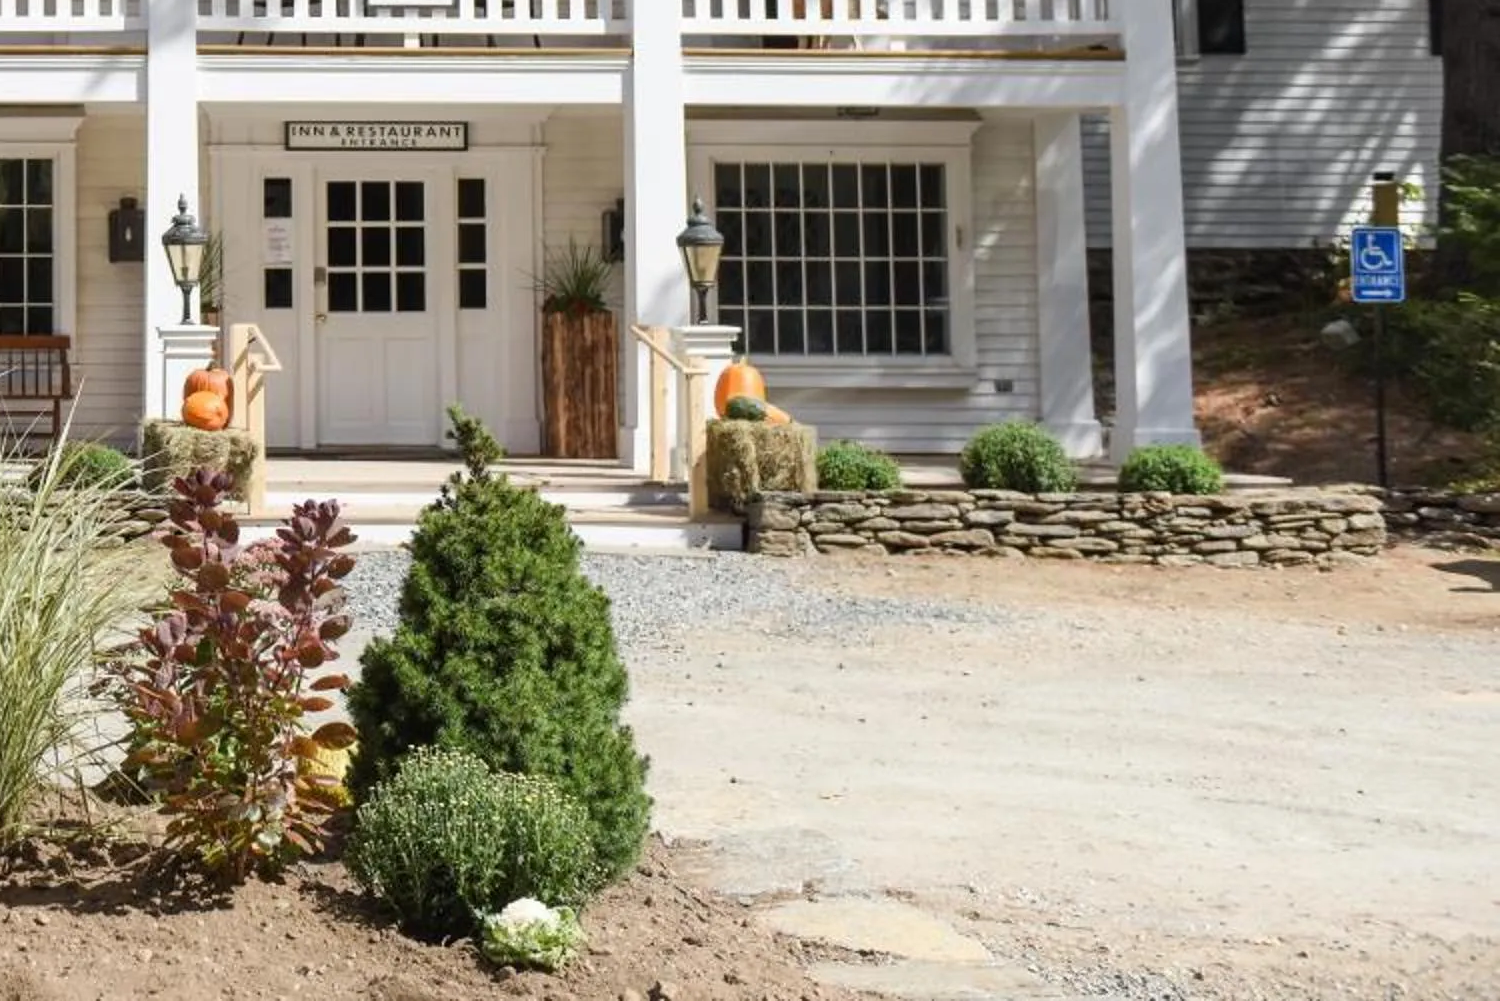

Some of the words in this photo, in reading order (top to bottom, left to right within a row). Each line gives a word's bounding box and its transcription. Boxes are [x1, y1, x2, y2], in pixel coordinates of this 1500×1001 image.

[290, 125, 325, 137] INN
[329, 125, 341, 137] &
[345, 125, 462, 138] RESTAURANT
[340, 138, 418, 148] ENTRANCE
